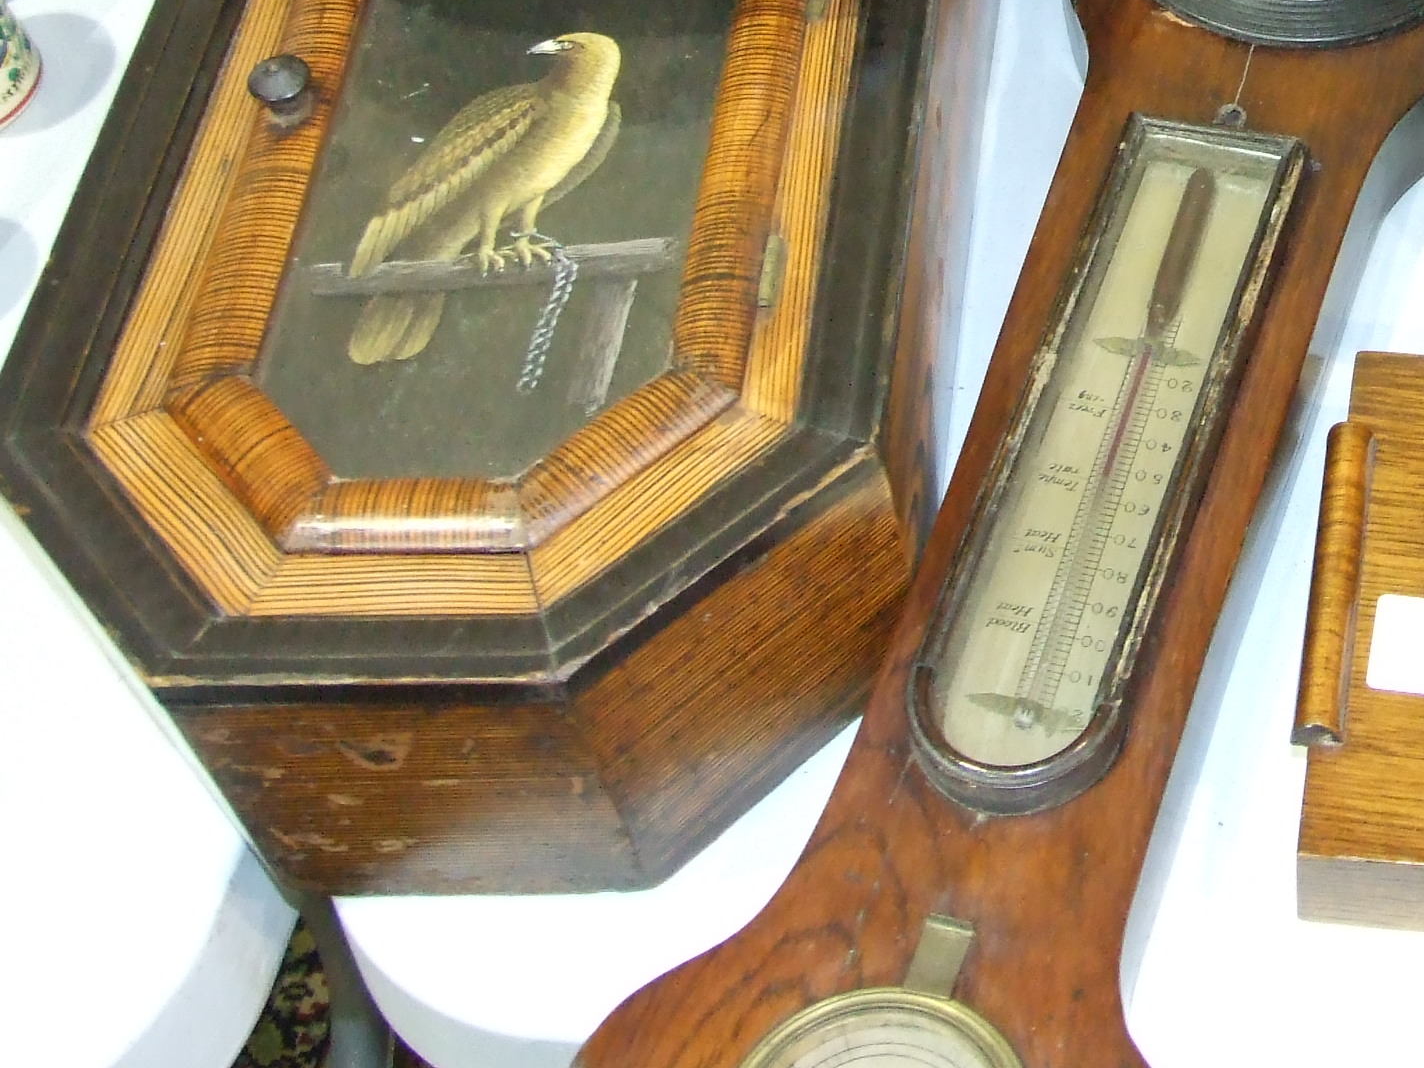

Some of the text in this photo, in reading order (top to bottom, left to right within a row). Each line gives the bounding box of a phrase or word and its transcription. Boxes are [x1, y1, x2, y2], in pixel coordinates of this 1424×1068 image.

[1166, 378, 1193, 393] 20
[1024, 528, 1062, 543] Heat
[1112, 533, 1136, 548] 70
[1103, 567, 1128, 584] 80
[997, 602, 1034, 617] Heat
[1091, 602, 1118, 619] 90
[985, 617, 1031, 634] Blood
